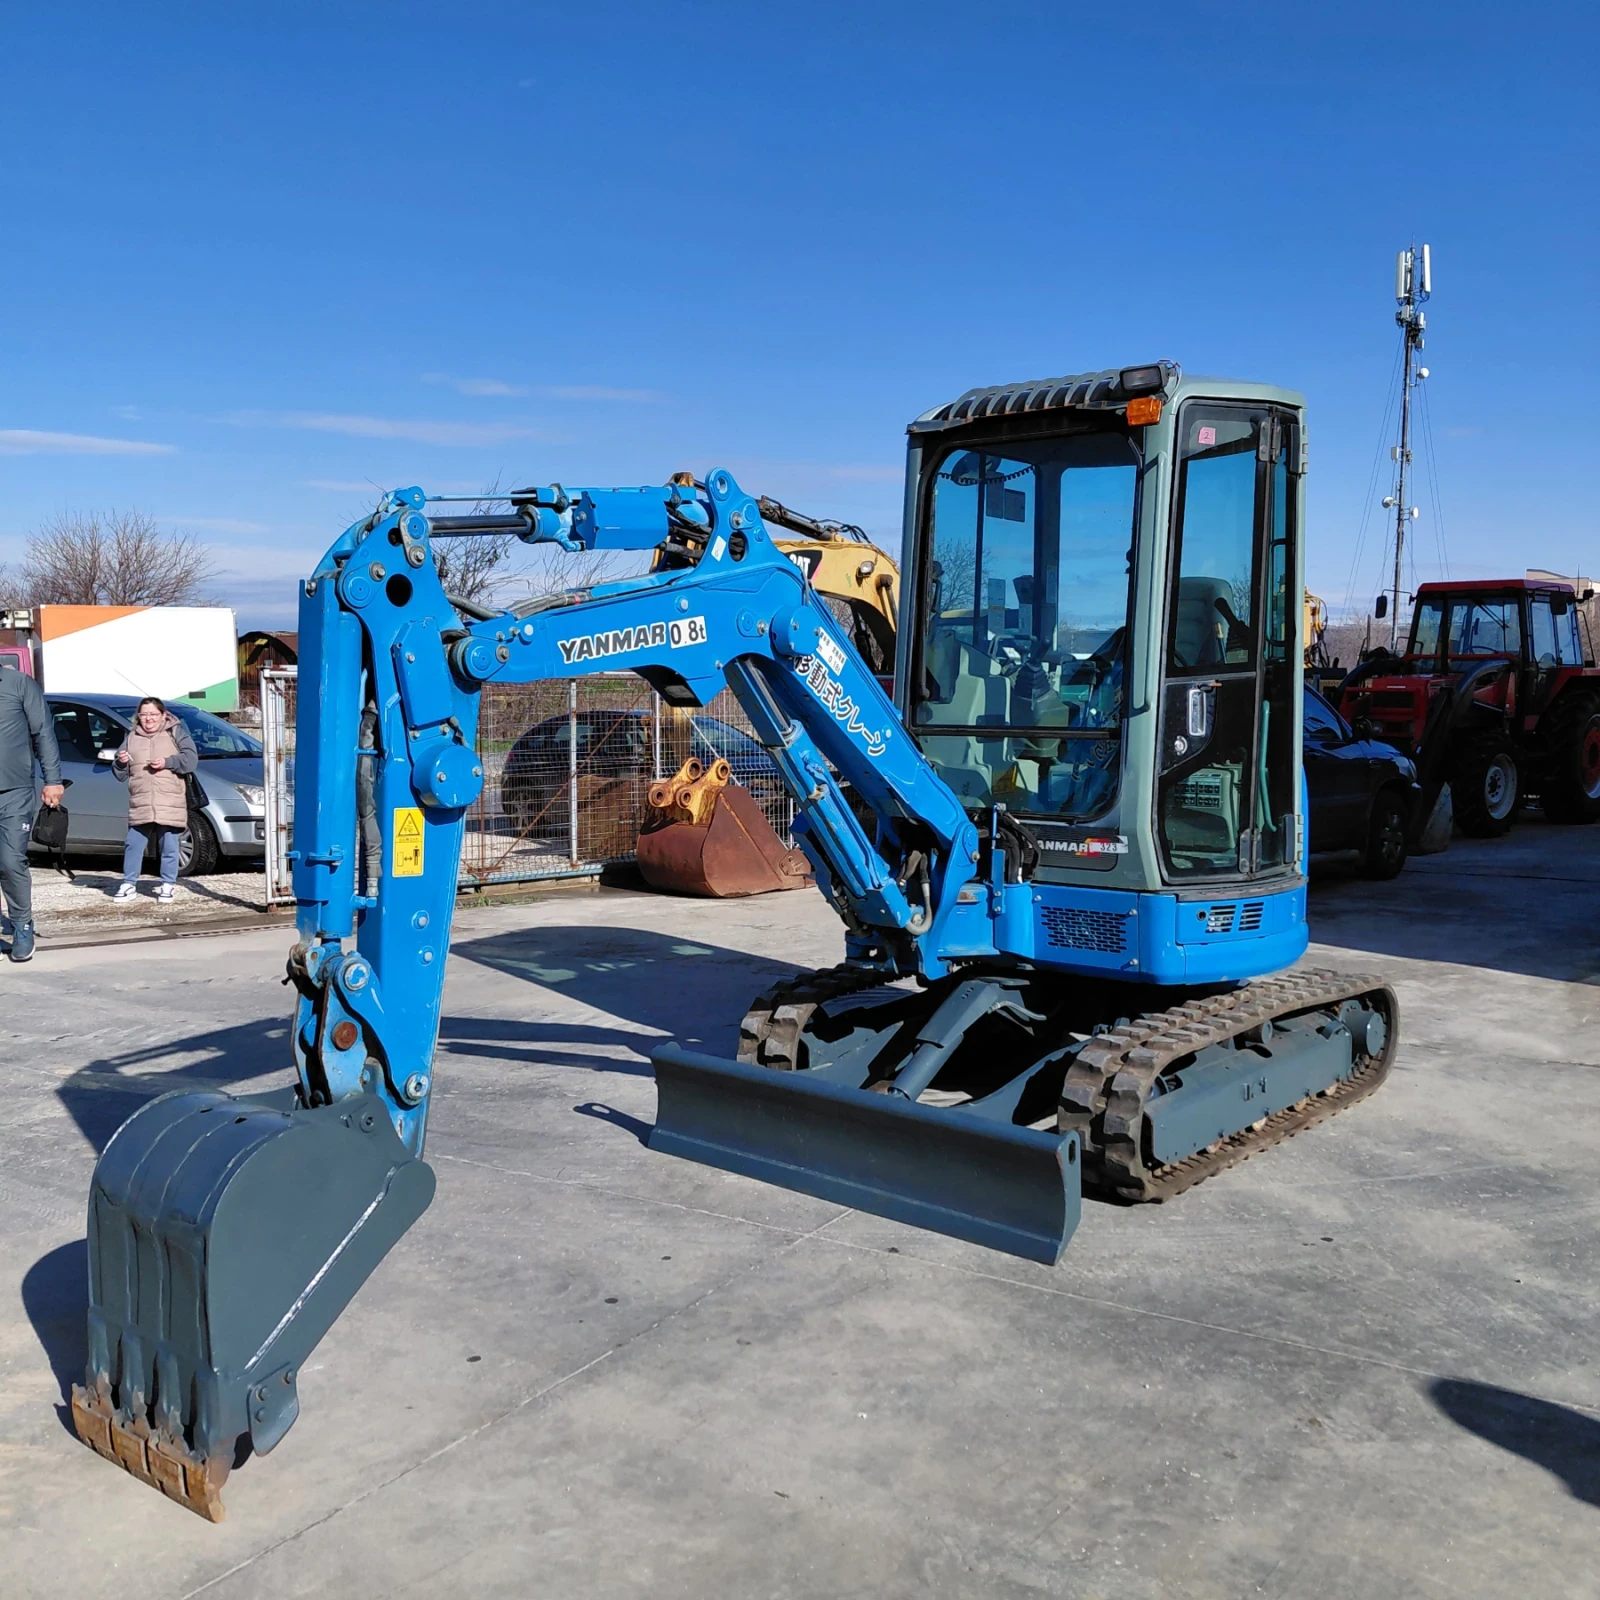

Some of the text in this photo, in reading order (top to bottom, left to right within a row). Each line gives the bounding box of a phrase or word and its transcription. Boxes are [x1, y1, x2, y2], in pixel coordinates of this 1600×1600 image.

[558, 623, 666, 663] YANMAR
[794, 655, 885, 756] 移動式クレーン
[1036, 839, 1118, 852] ANMAR 323
